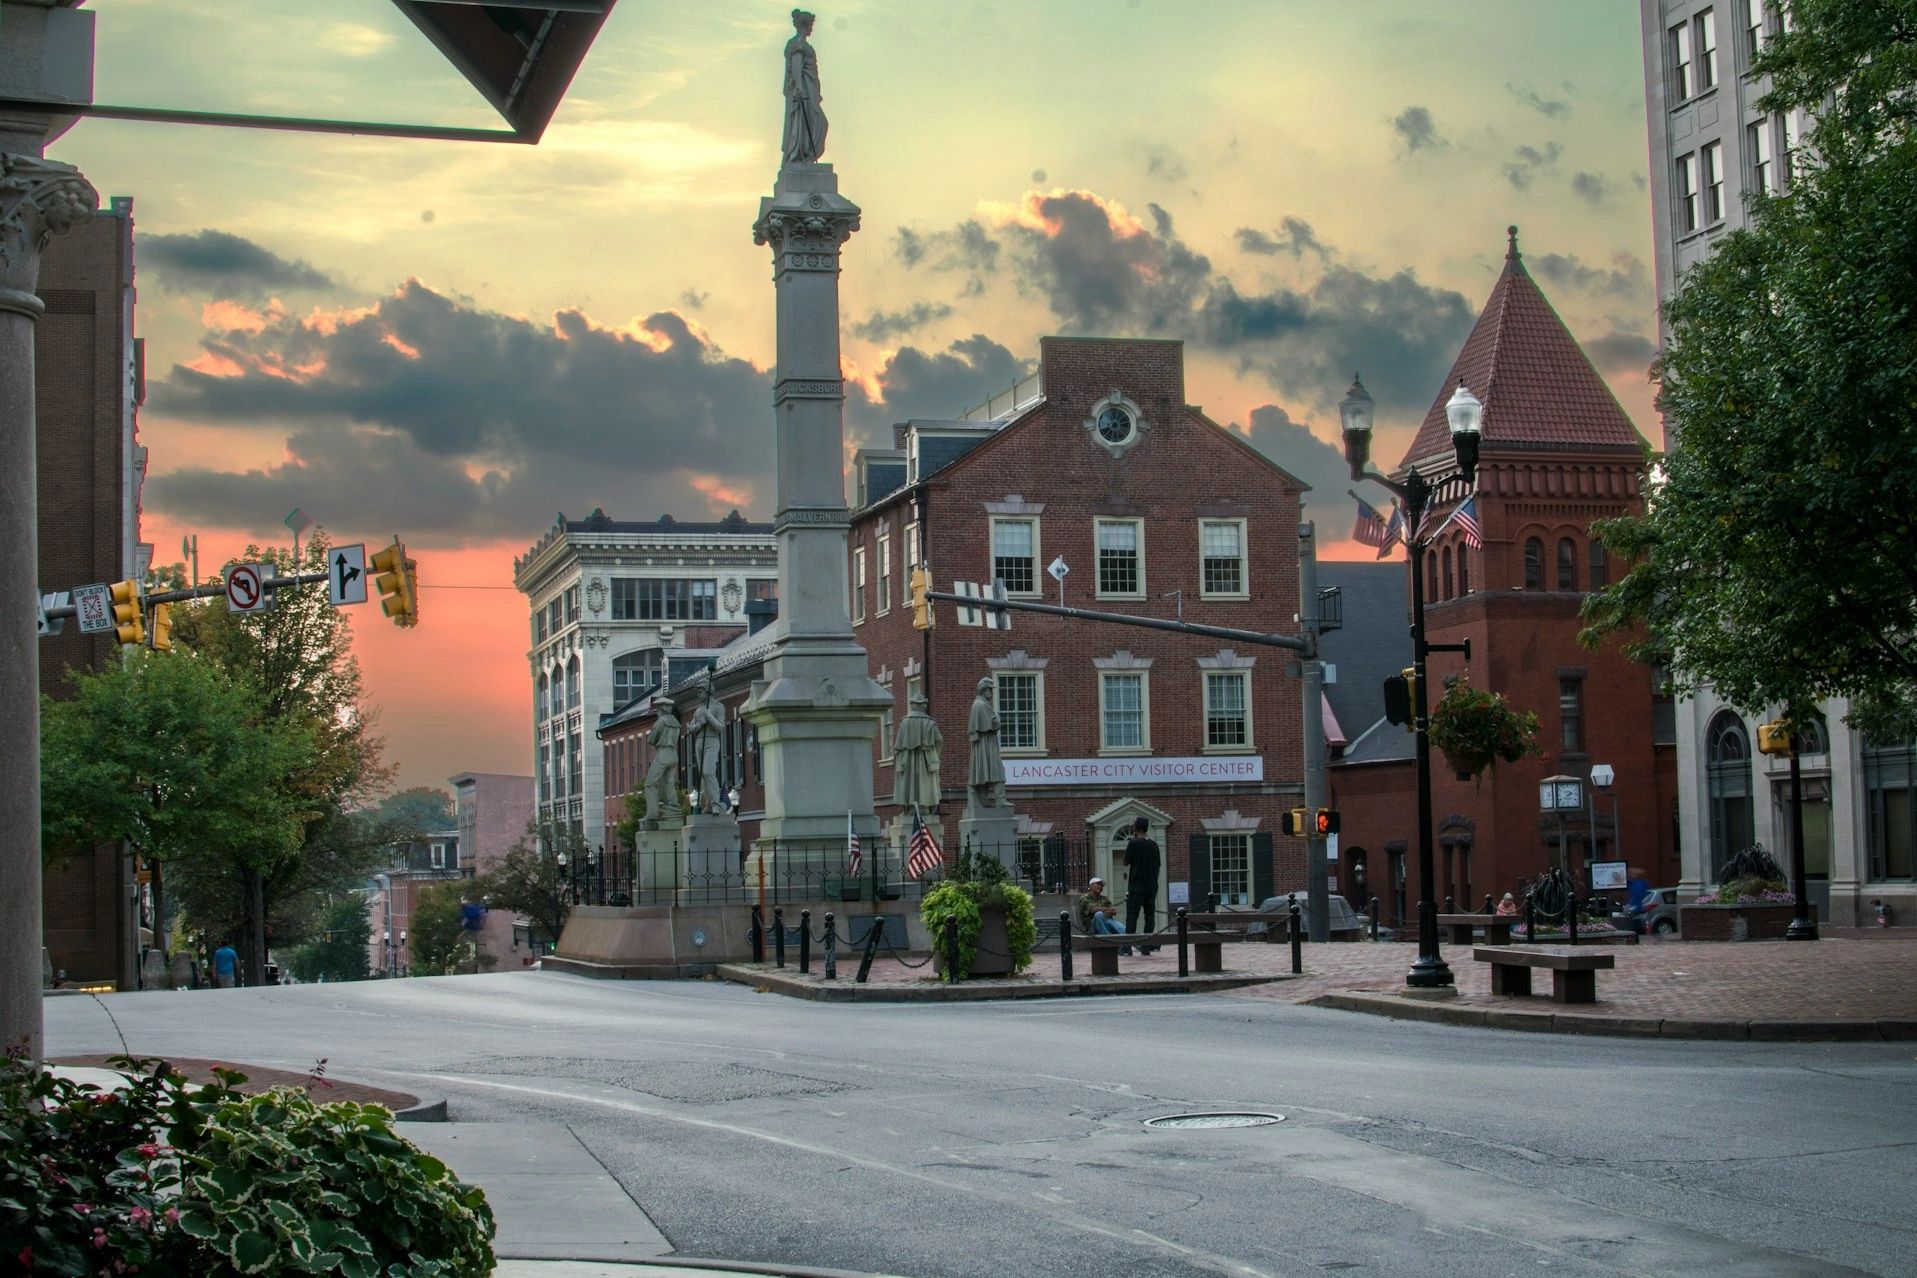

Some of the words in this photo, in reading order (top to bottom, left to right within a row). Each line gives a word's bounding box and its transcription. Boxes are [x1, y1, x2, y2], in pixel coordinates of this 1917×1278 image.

[82, 620, 95, 630] THE
[95, 618, 109, 628] BOX
[1013, 765, 1098, 778] LANCASTER
[1103, 764, 1135, 777] CITY
[1139, 763, 1195, 776] VISITOR
[1199, 762, 1255, 776] CENTER
